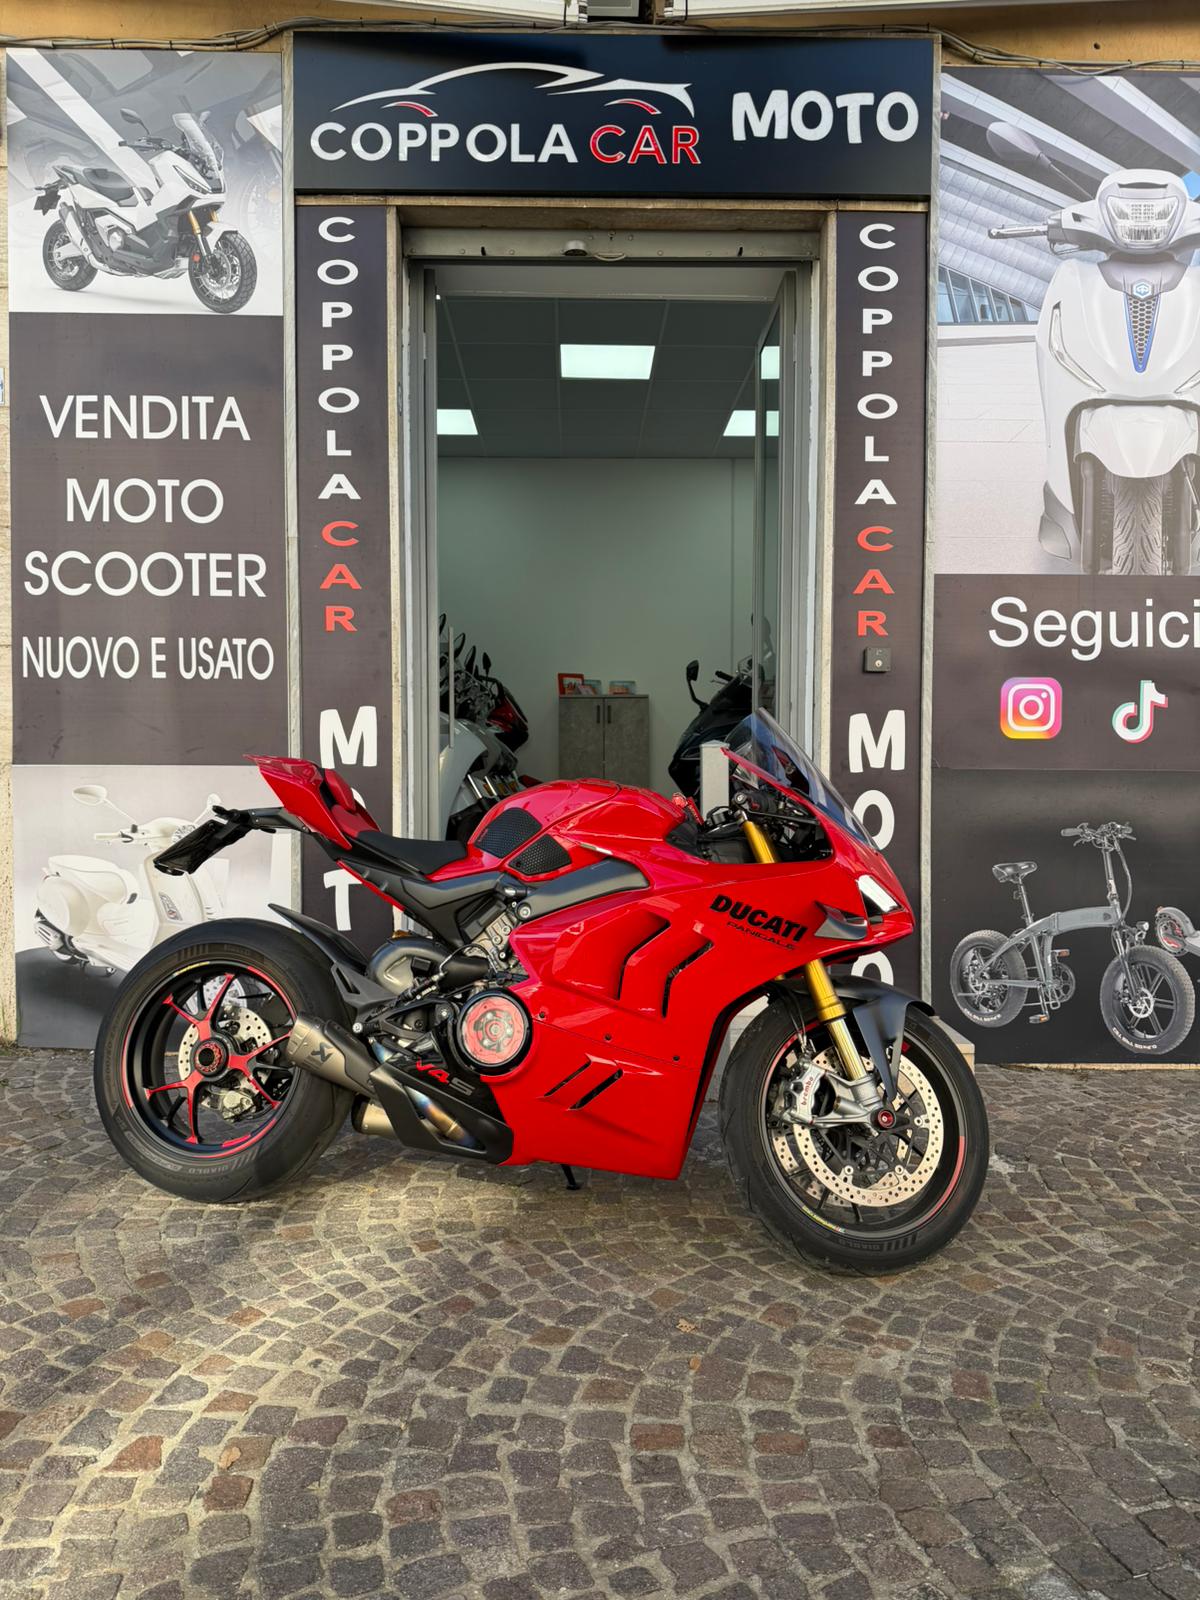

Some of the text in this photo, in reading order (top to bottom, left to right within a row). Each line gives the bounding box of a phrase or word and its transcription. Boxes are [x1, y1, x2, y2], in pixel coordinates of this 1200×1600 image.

[310, 89, 920, 165] COPPOLA CAR MOTO
[317, 216, 362, 500] COPPOLA
[39, 395, 251, 441] VENDITA
[66, 477, 224, 524] MOTO
[24, 550, 267, 598] SCOOTER
[319, 521, 362, 633] CAR
[848, 223, 906, 986] COPPOLA CAR MOO
[989, 596, 1200, 660] Seguici
[22, 636, 275, 681] NUOVO E USATO
[709, 894, 808, 942] DUCATI
[801, 1076, 814, 1106] brembo
